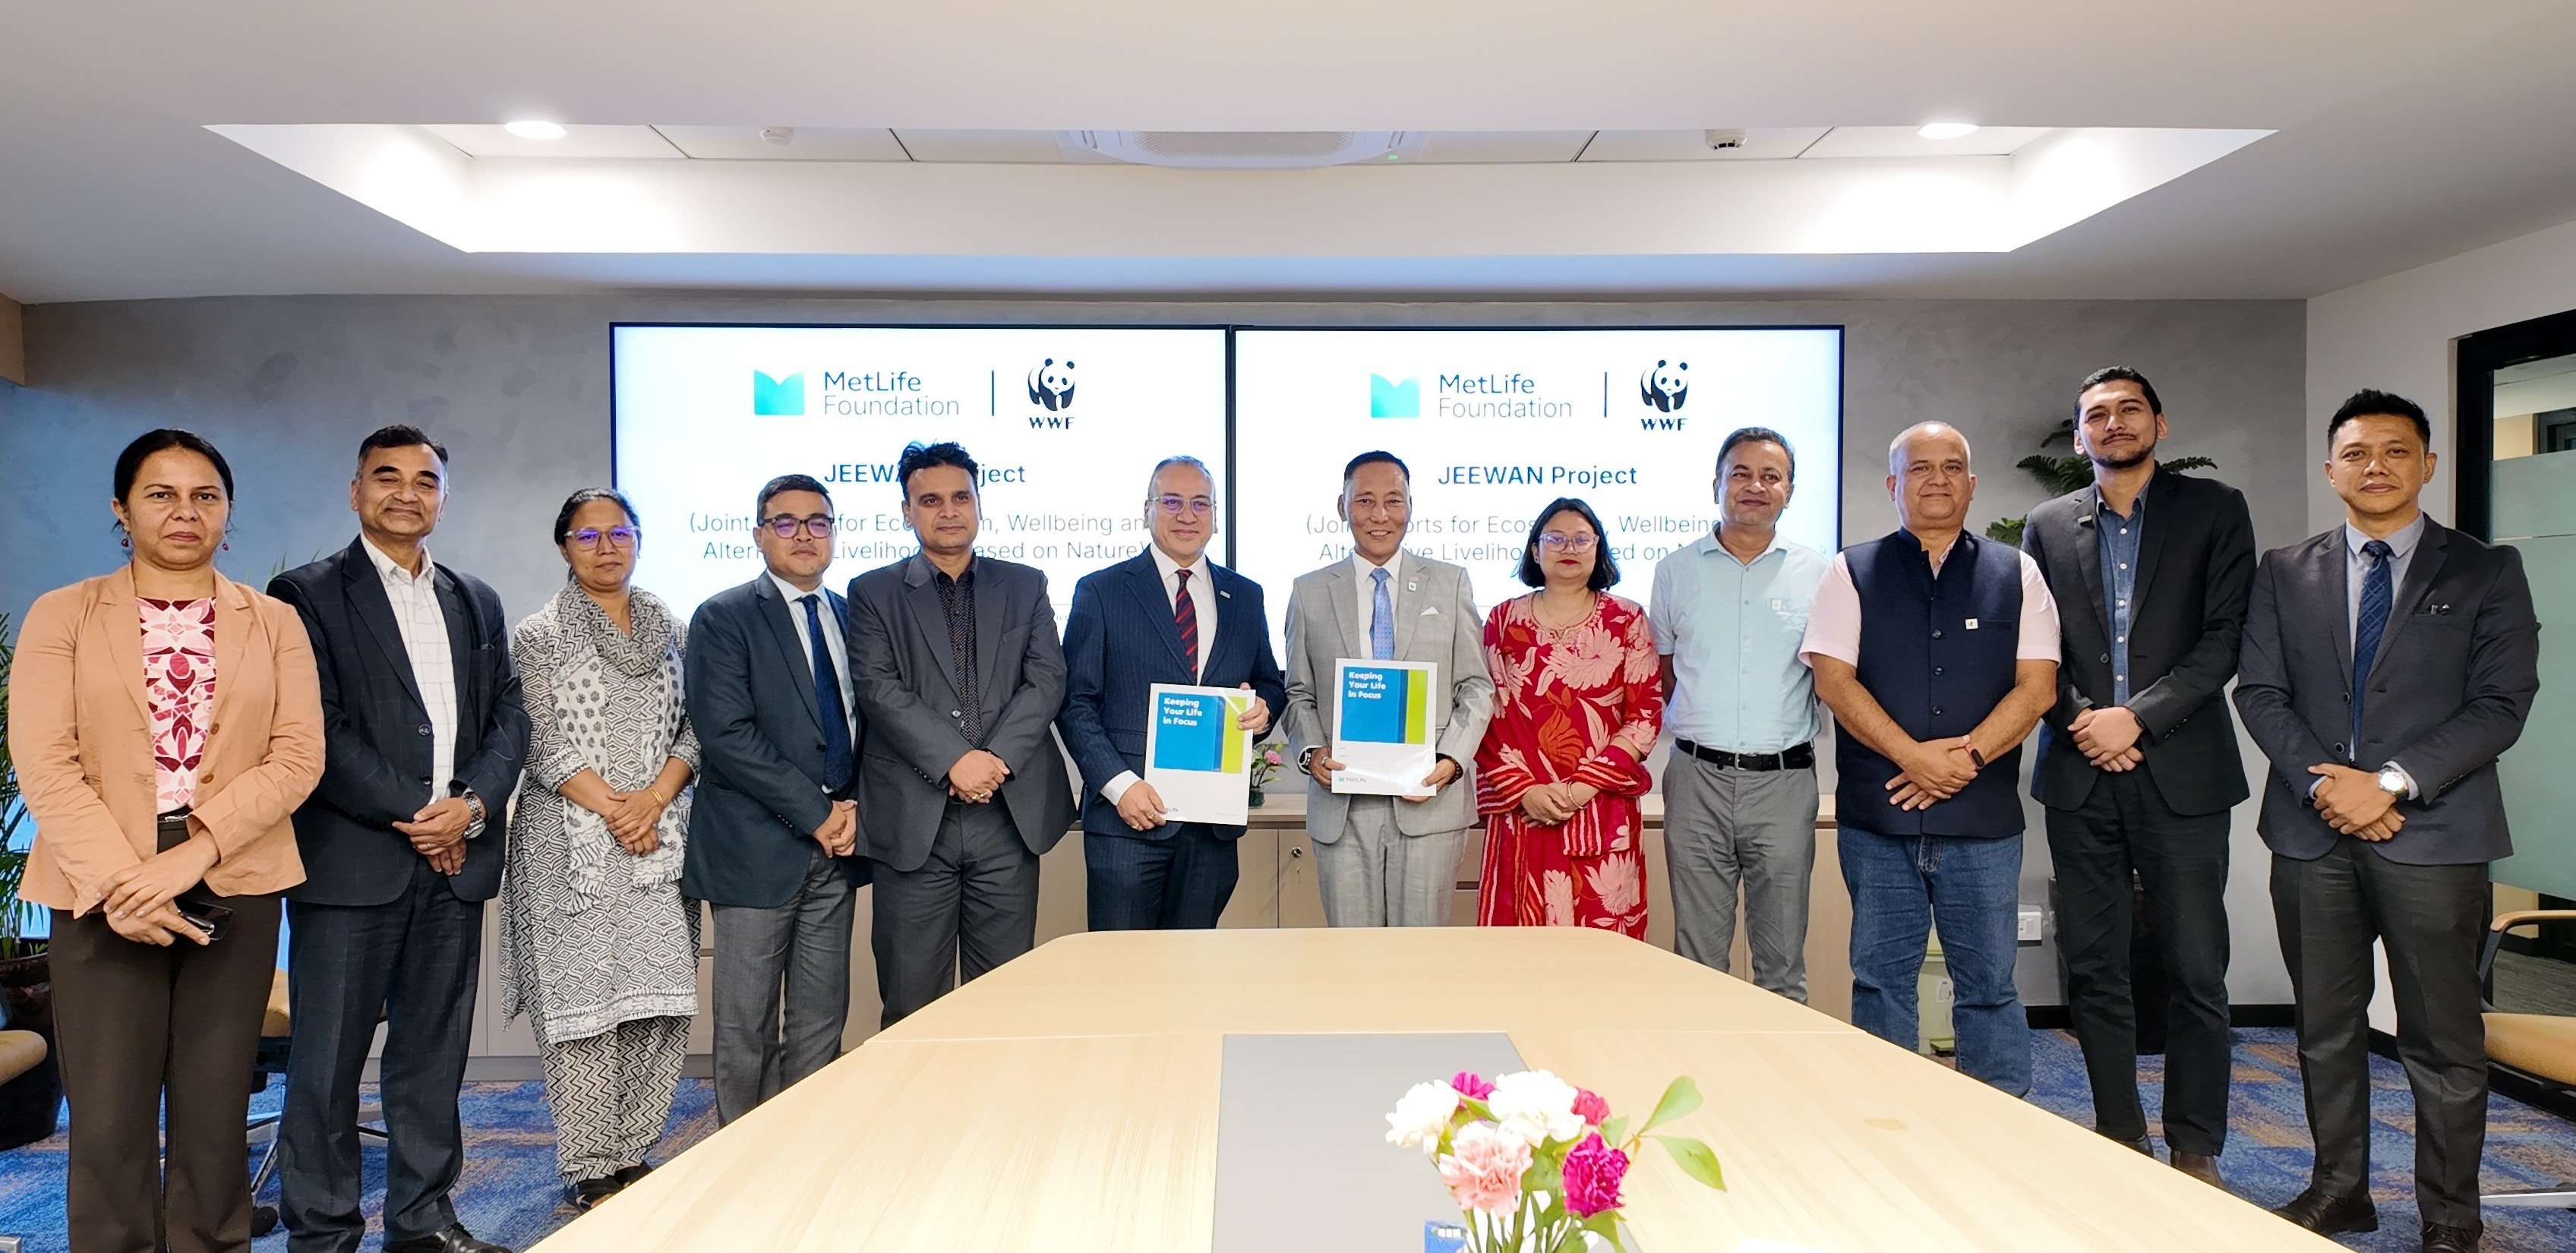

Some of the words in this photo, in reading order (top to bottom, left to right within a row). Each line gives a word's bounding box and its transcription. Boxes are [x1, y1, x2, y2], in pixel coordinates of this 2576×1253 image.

[824, 371, 921, 392] MetLife
[1439, 373, 1535, 393] MetLife
[825, 395, 960, 416] Foundation
[1439, 398, 1572, 418] Foundation
[1029, 417, 1075, 430] WWF
[1641, 418, 1687, 431] WWF
[824, 464, 901, 483] JEEW
[1438, 466, 1542, 484] JEEWAN
[1552, 465, 1637, 489] Project
[690, 512, 750, 534] (Joint
[838, 513, 867, 532] for
[1008, 513, 1112, 536] Wellbeing
[1451, 516, 1479, 533] for
[974, 542, 1024, 559] ased
[1033, 545, 1058, 559] on
[1348, 671, 1383, 682] Keeping
[1348, 680, 1369, 689] Your
[1370, 681, 1387, 690] Life
[1163, 697, 1200, 709] Keeping
[1358, 690, 1382, 699] Focus
[1163, 707, 1185, 715] Your
[1185, 708, 1203, 717] Life
[1173, 717, 1198, 727] Focus
